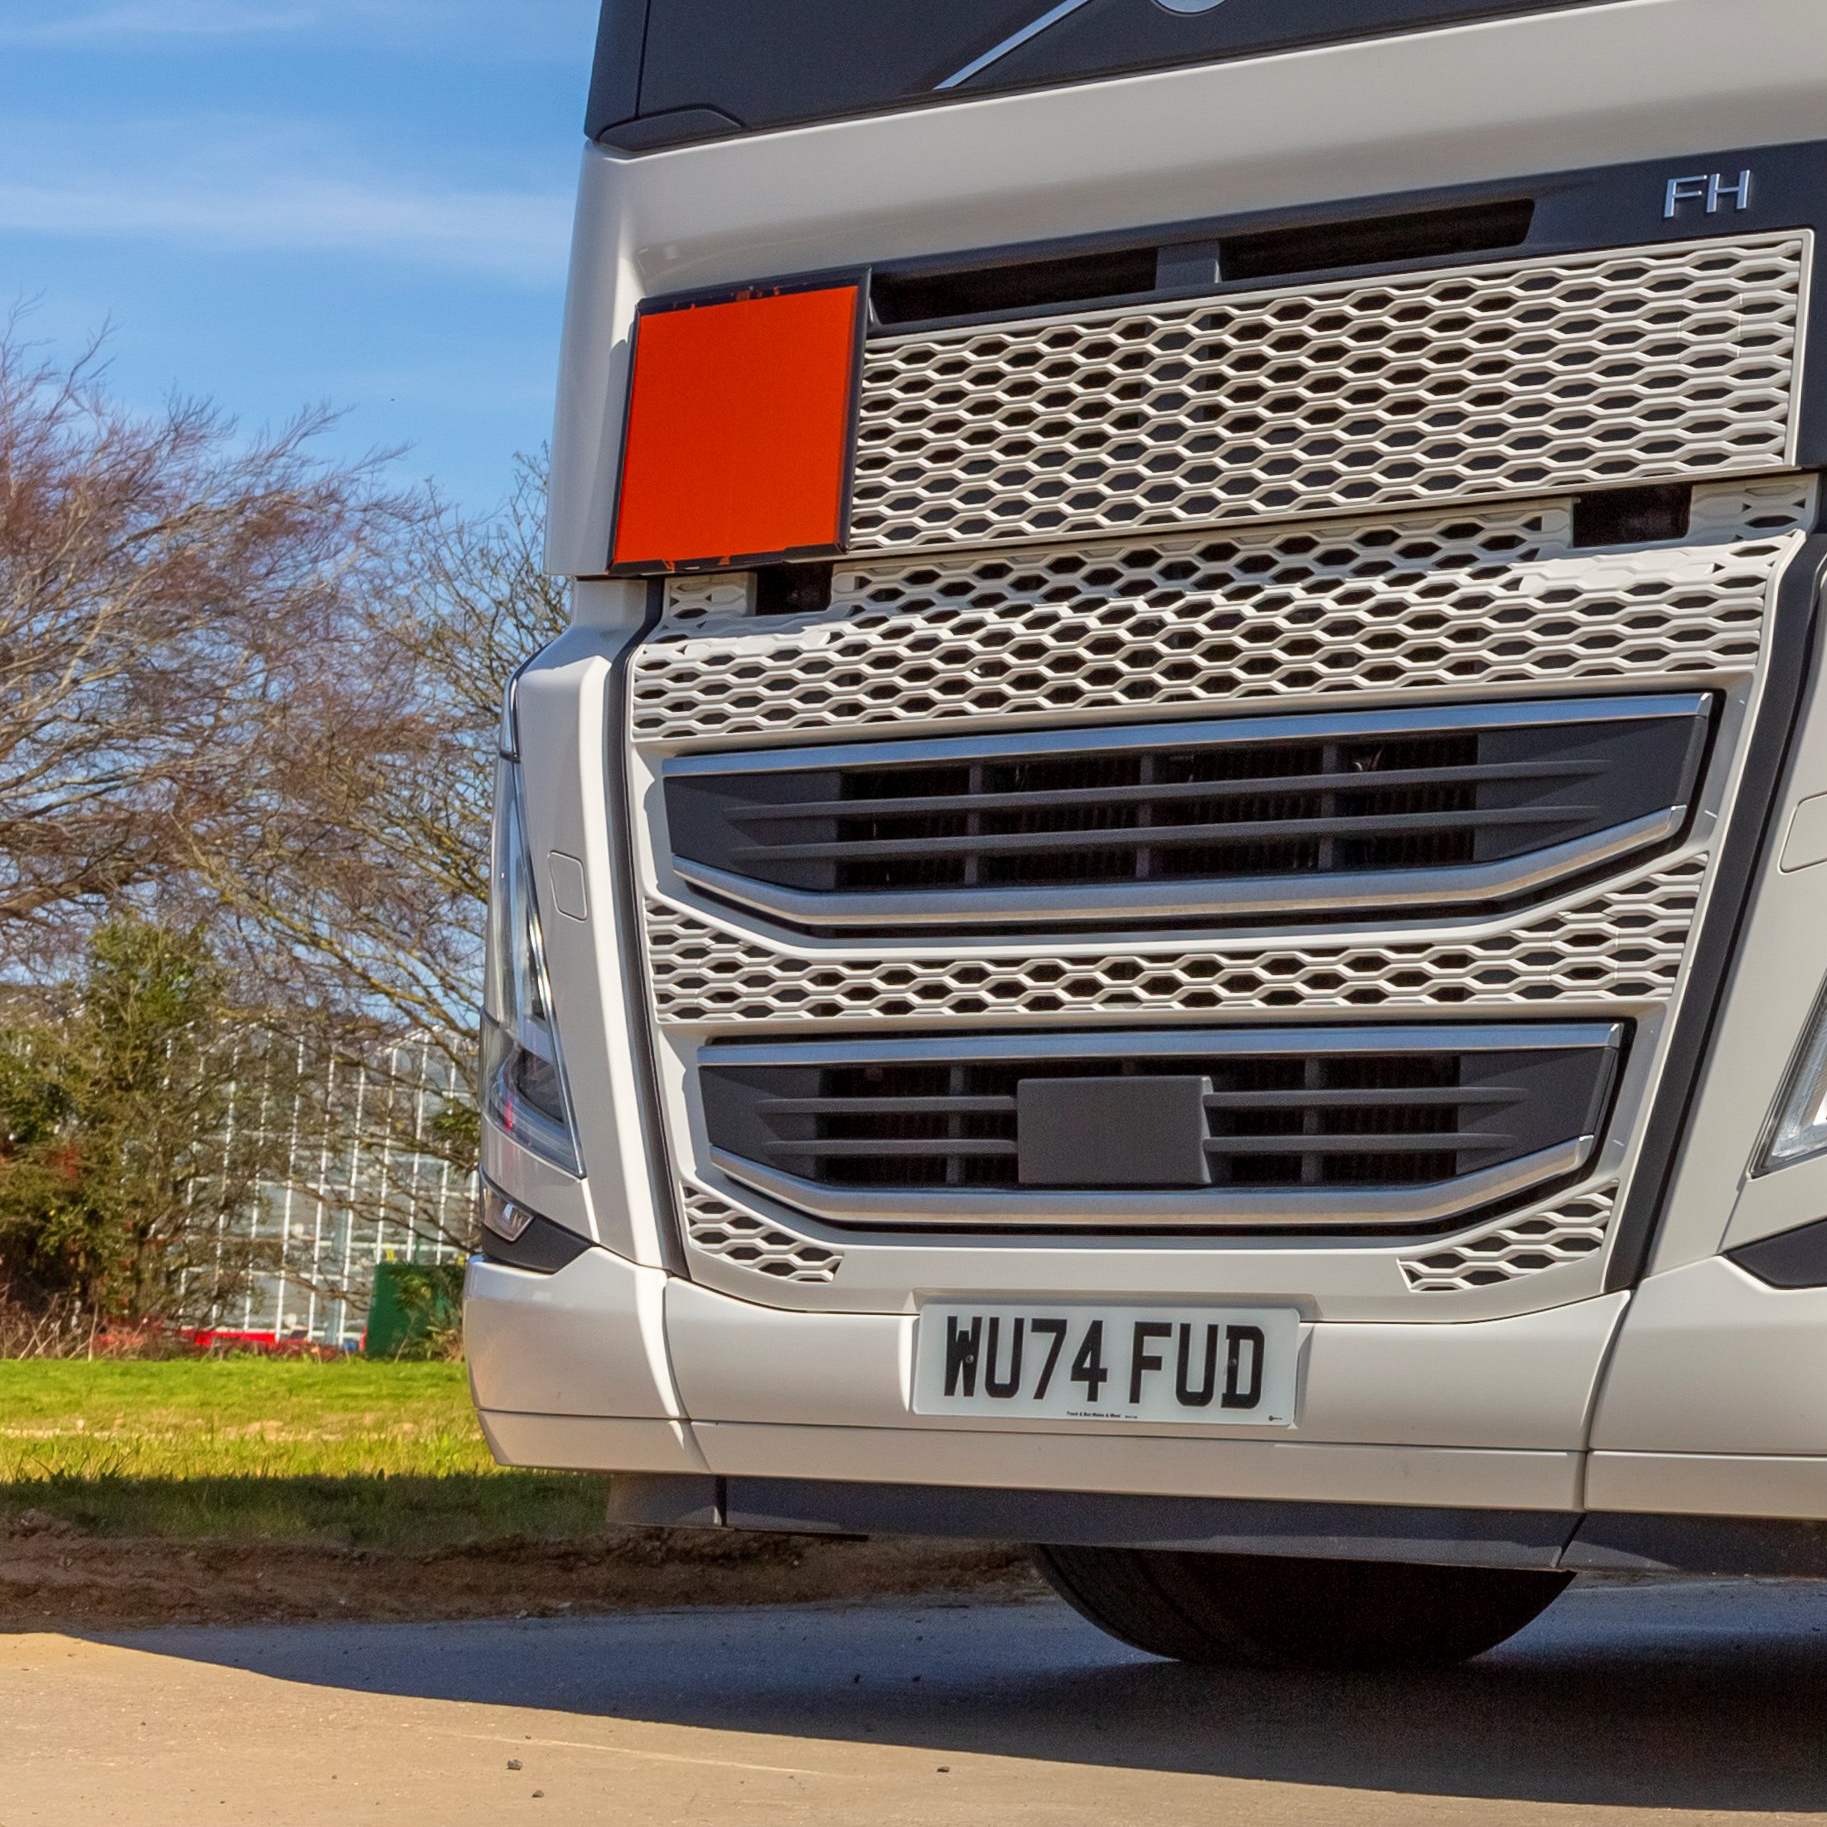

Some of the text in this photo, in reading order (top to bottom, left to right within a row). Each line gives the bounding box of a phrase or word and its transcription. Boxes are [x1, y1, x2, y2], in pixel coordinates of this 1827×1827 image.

[1664, 169, 1751, 218] FH
[943, 1315, 1266, 1410] WU74 FUD
